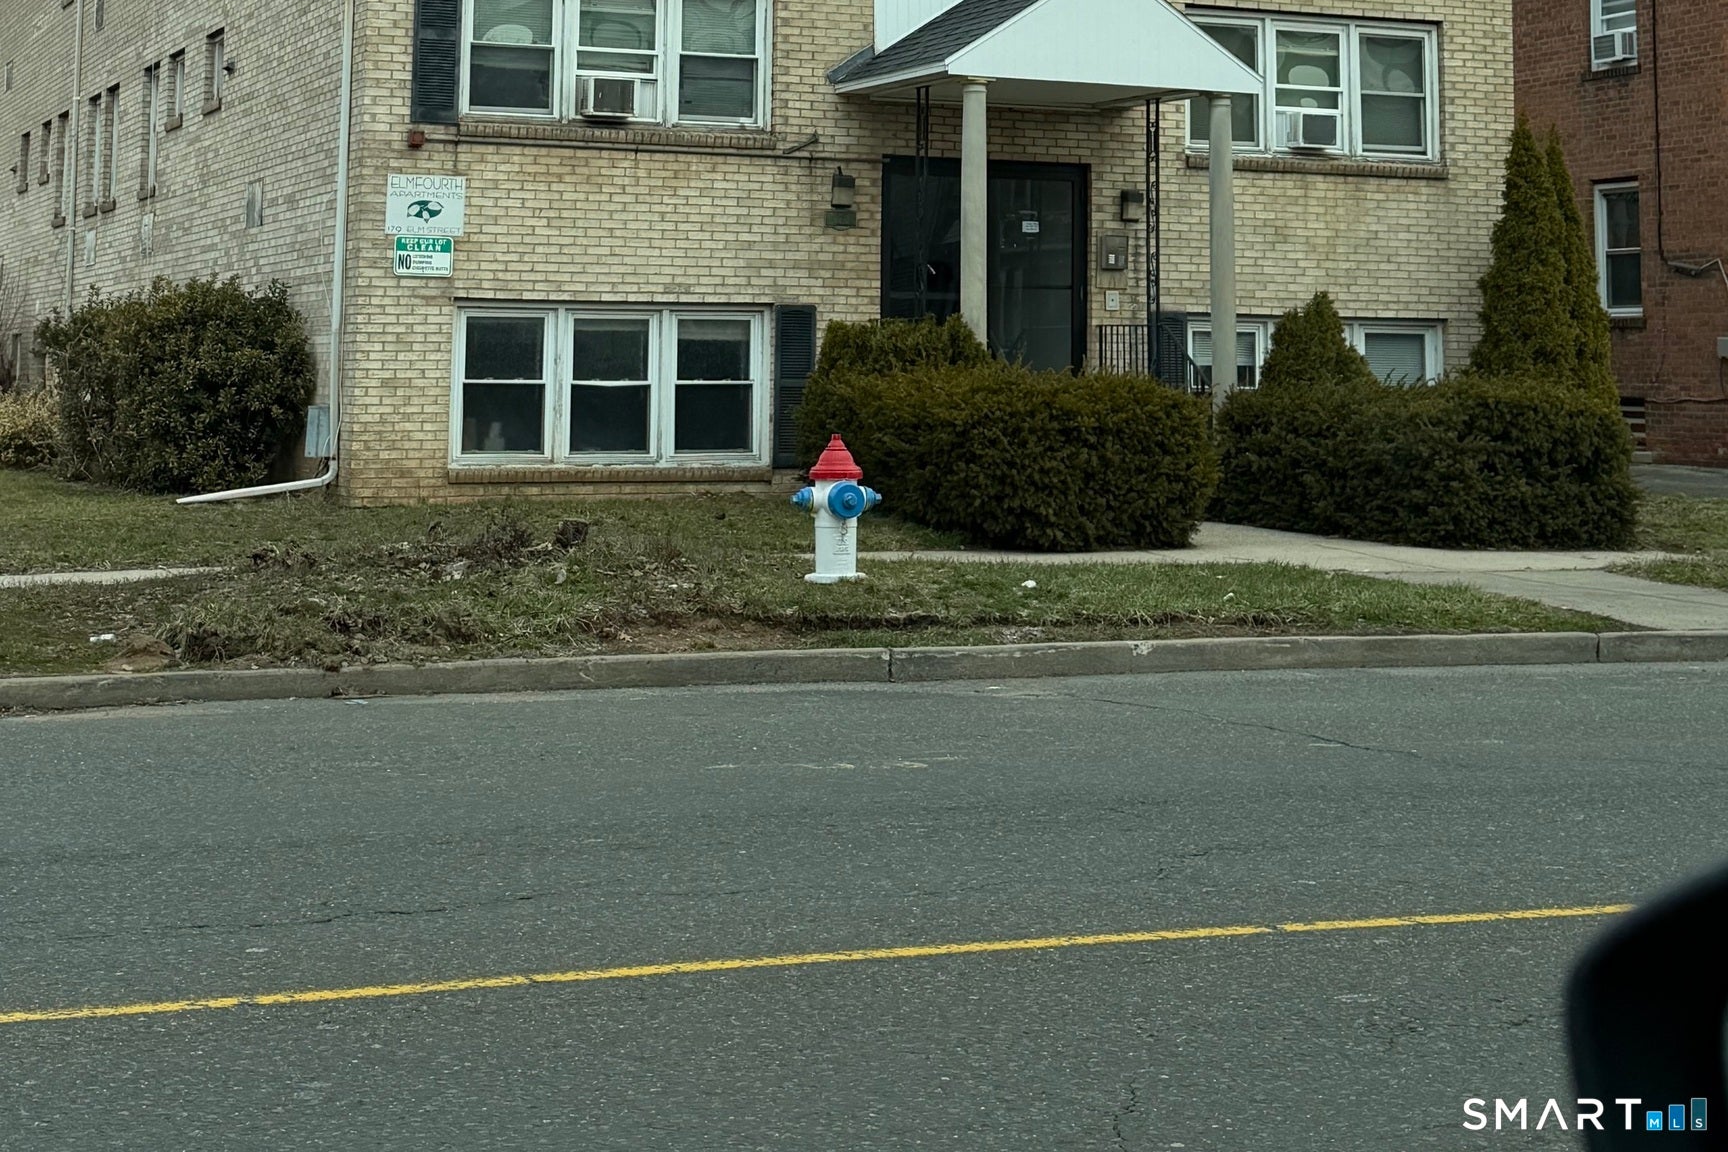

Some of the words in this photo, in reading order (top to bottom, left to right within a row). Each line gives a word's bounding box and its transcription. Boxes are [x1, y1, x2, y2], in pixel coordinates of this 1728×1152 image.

[391, 176, 463, 190] ELMFOURTH
[390, 191, 463, 199] APARTMENTS
[387, 225, 402, 233] 179
[426, 226, 461, 234] STREET
[407, 244, 441, 252] CLEAN
[398, 253, 412, 270] NO
